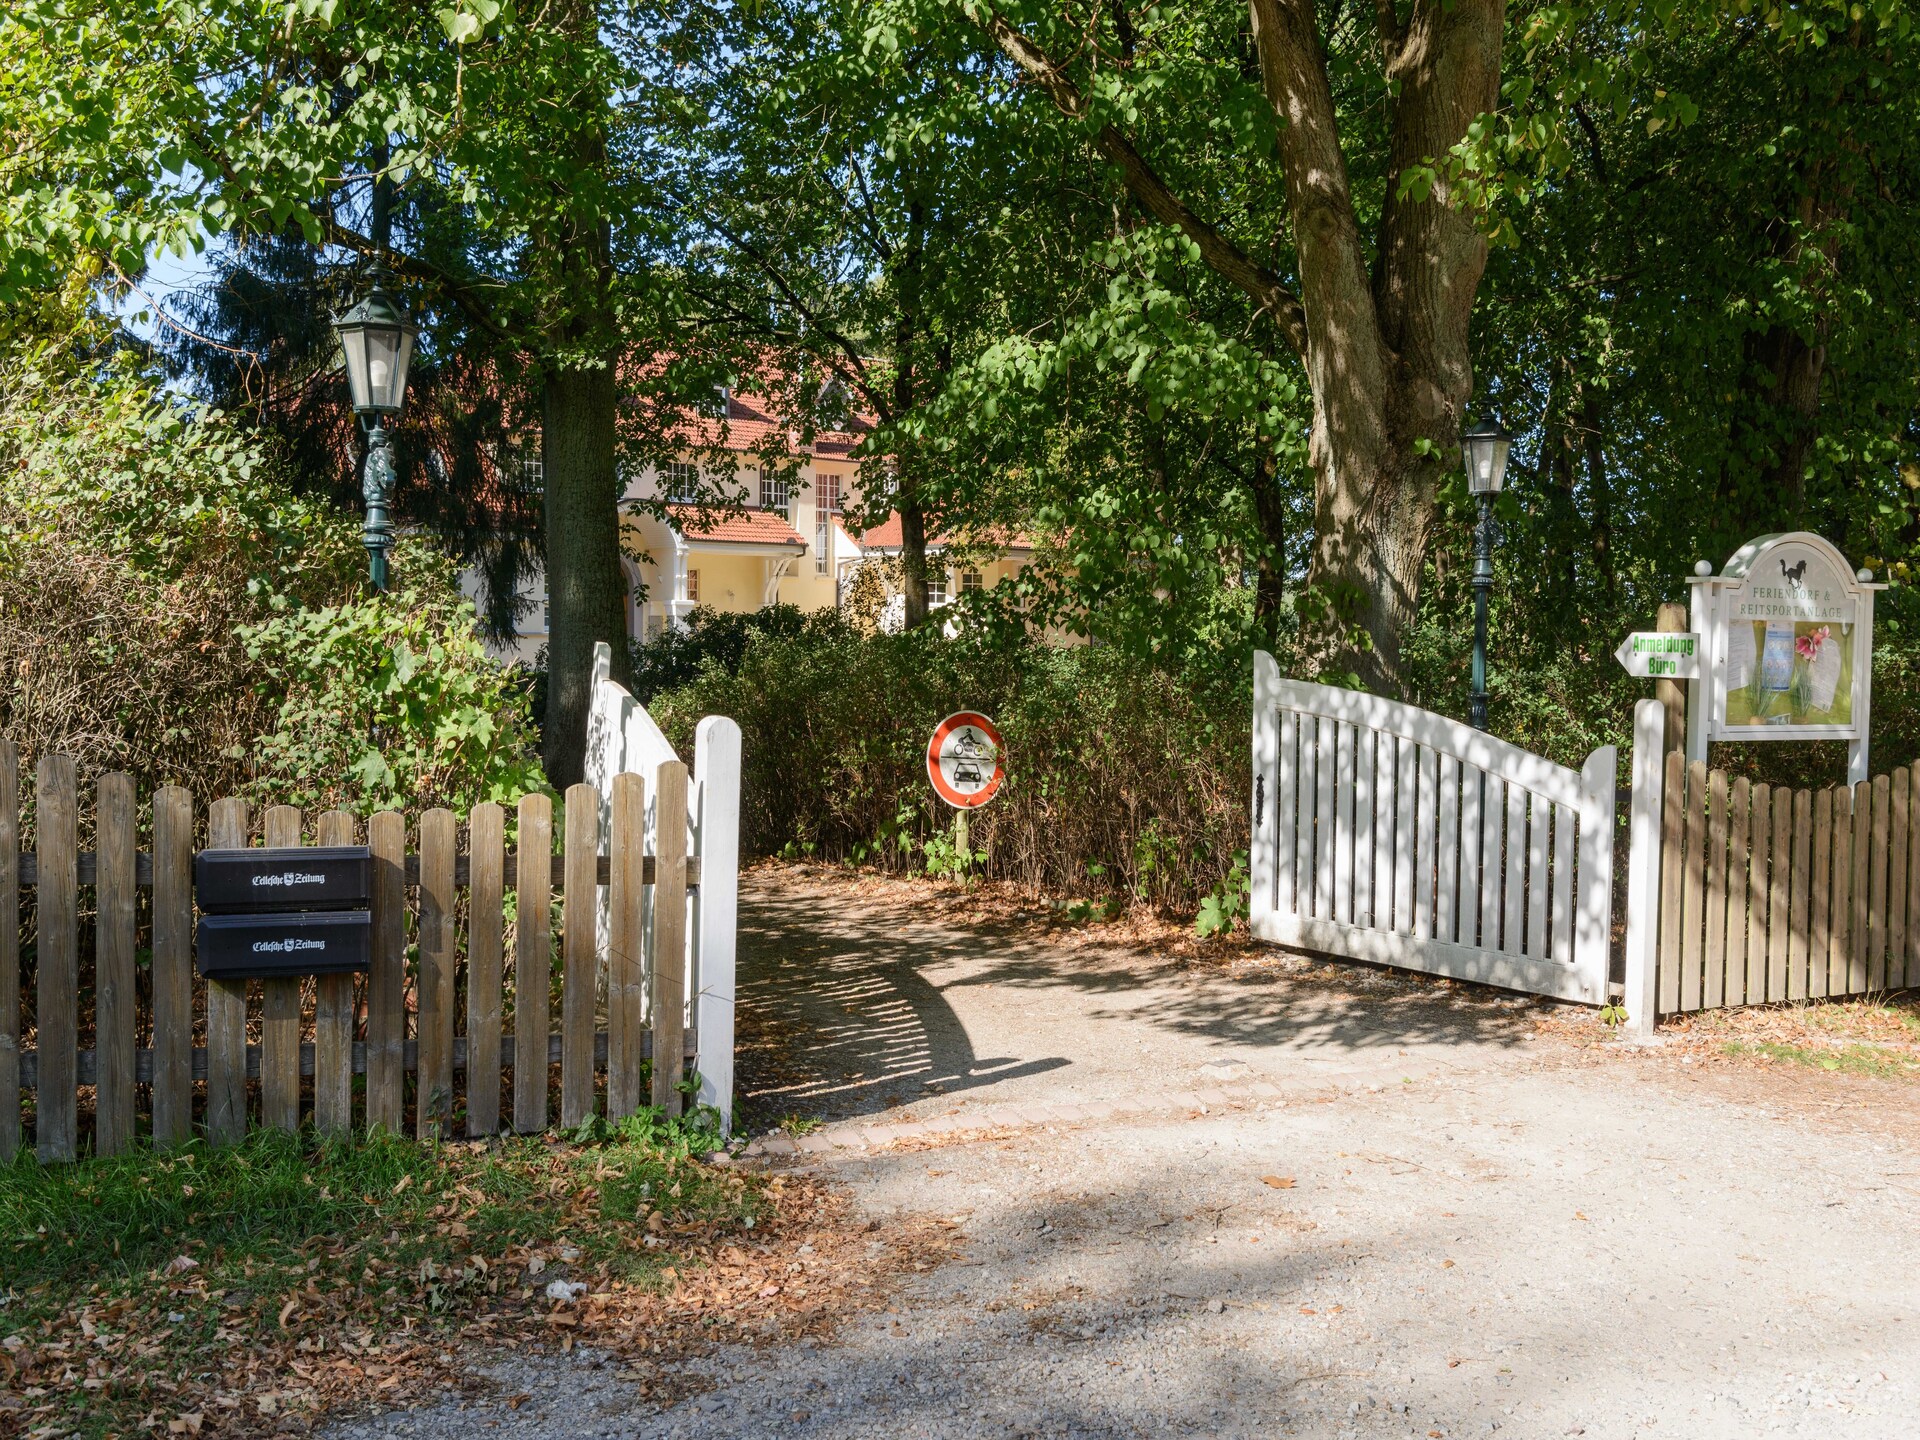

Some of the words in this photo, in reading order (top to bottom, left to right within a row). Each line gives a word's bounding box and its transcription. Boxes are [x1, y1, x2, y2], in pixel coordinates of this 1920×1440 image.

[1753, 587, 1819, 600] FERIENDORF
[1824, 590, 1830, 601] &
[1740, 603, 1842, 618] REITSPORTANLAGE
[1633, 636, 1694, 656] Anmeldung
[1648, 656, 1676, 675] Büro
[294, 873, 325, 884] Zeitung
[294, 939, 325, 950] Zeitung
